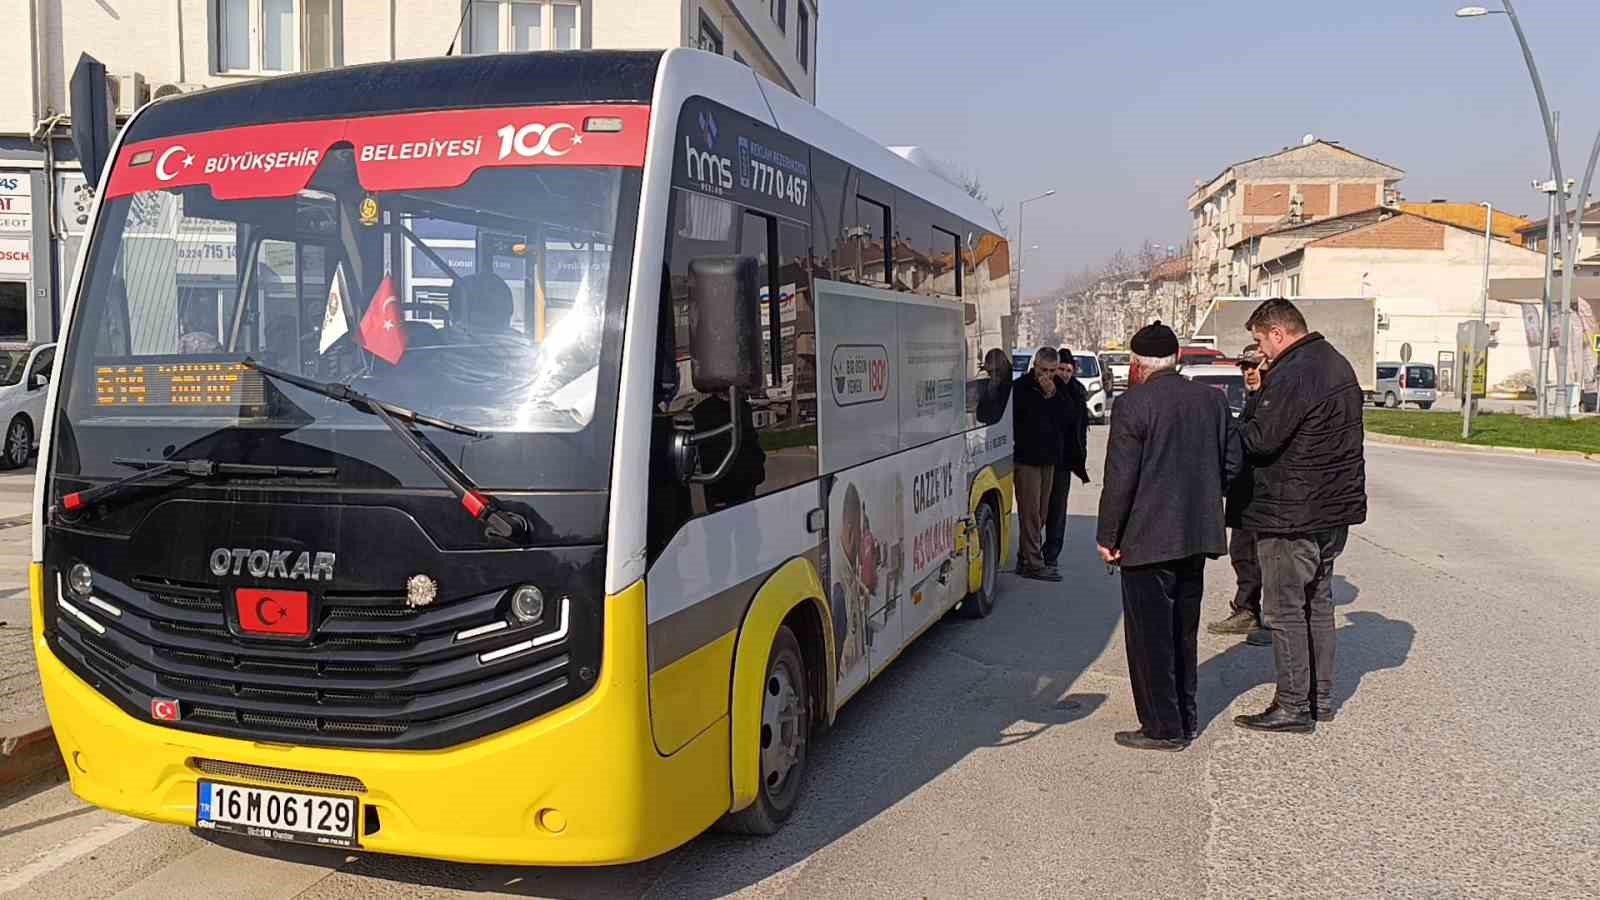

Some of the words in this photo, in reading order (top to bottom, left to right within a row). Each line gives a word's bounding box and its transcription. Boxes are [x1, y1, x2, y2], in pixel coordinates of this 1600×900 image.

[204, 148, 319, 175] BÜYÜKŞEHİR
[360, 135, 482, 162] BELEDİYESİ
[686, 135, 732, 189] hms
[209, 547, 336, 581] OTOKAR
[216, 788, 241, 820] 16
[247, 791, 261, 823] M
[267, 795, 350, 832] 06129
